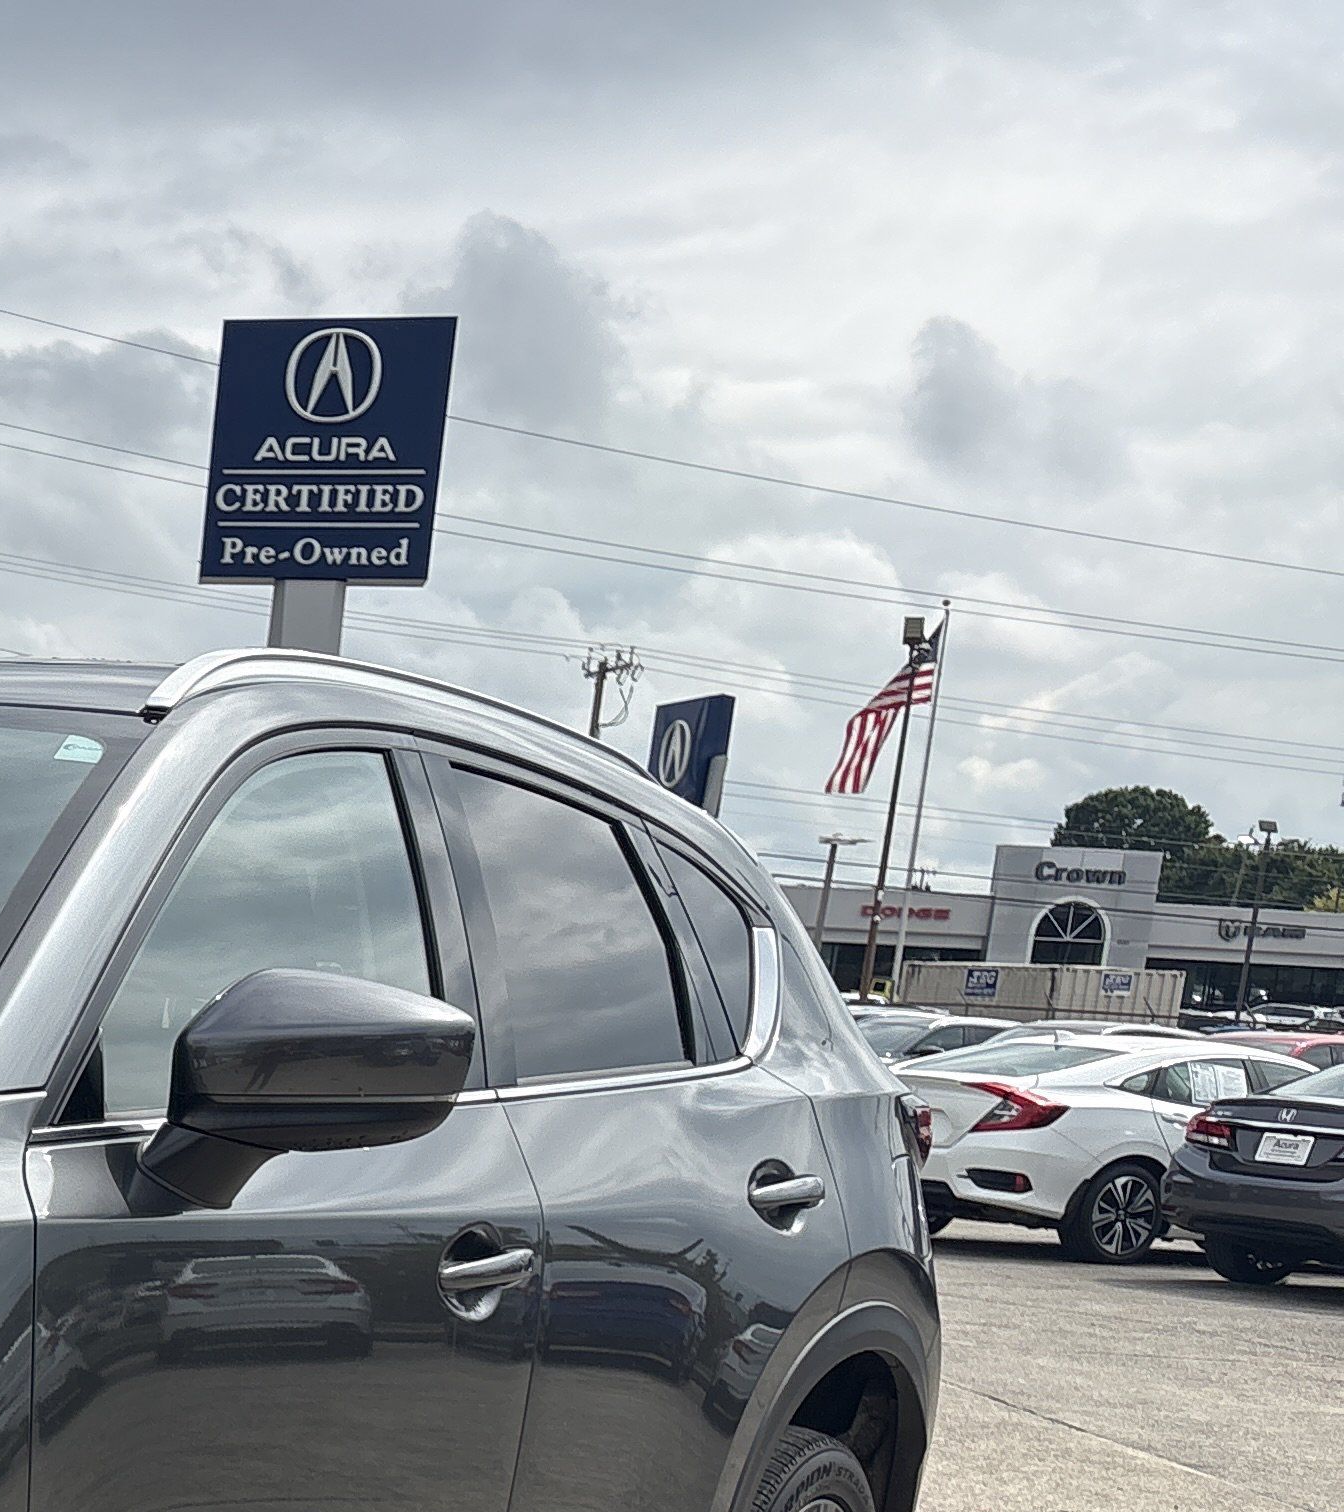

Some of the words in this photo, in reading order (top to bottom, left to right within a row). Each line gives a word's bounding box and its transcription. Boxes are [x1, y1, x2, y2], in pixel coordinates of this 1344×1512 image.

[254, 436, 397, 462] ACURA
[215, 483, 425, 513] CERTIFIED
[220, 537, 410, 566] Pre-Owned
[1034, 861, 1127, 885] Crown
